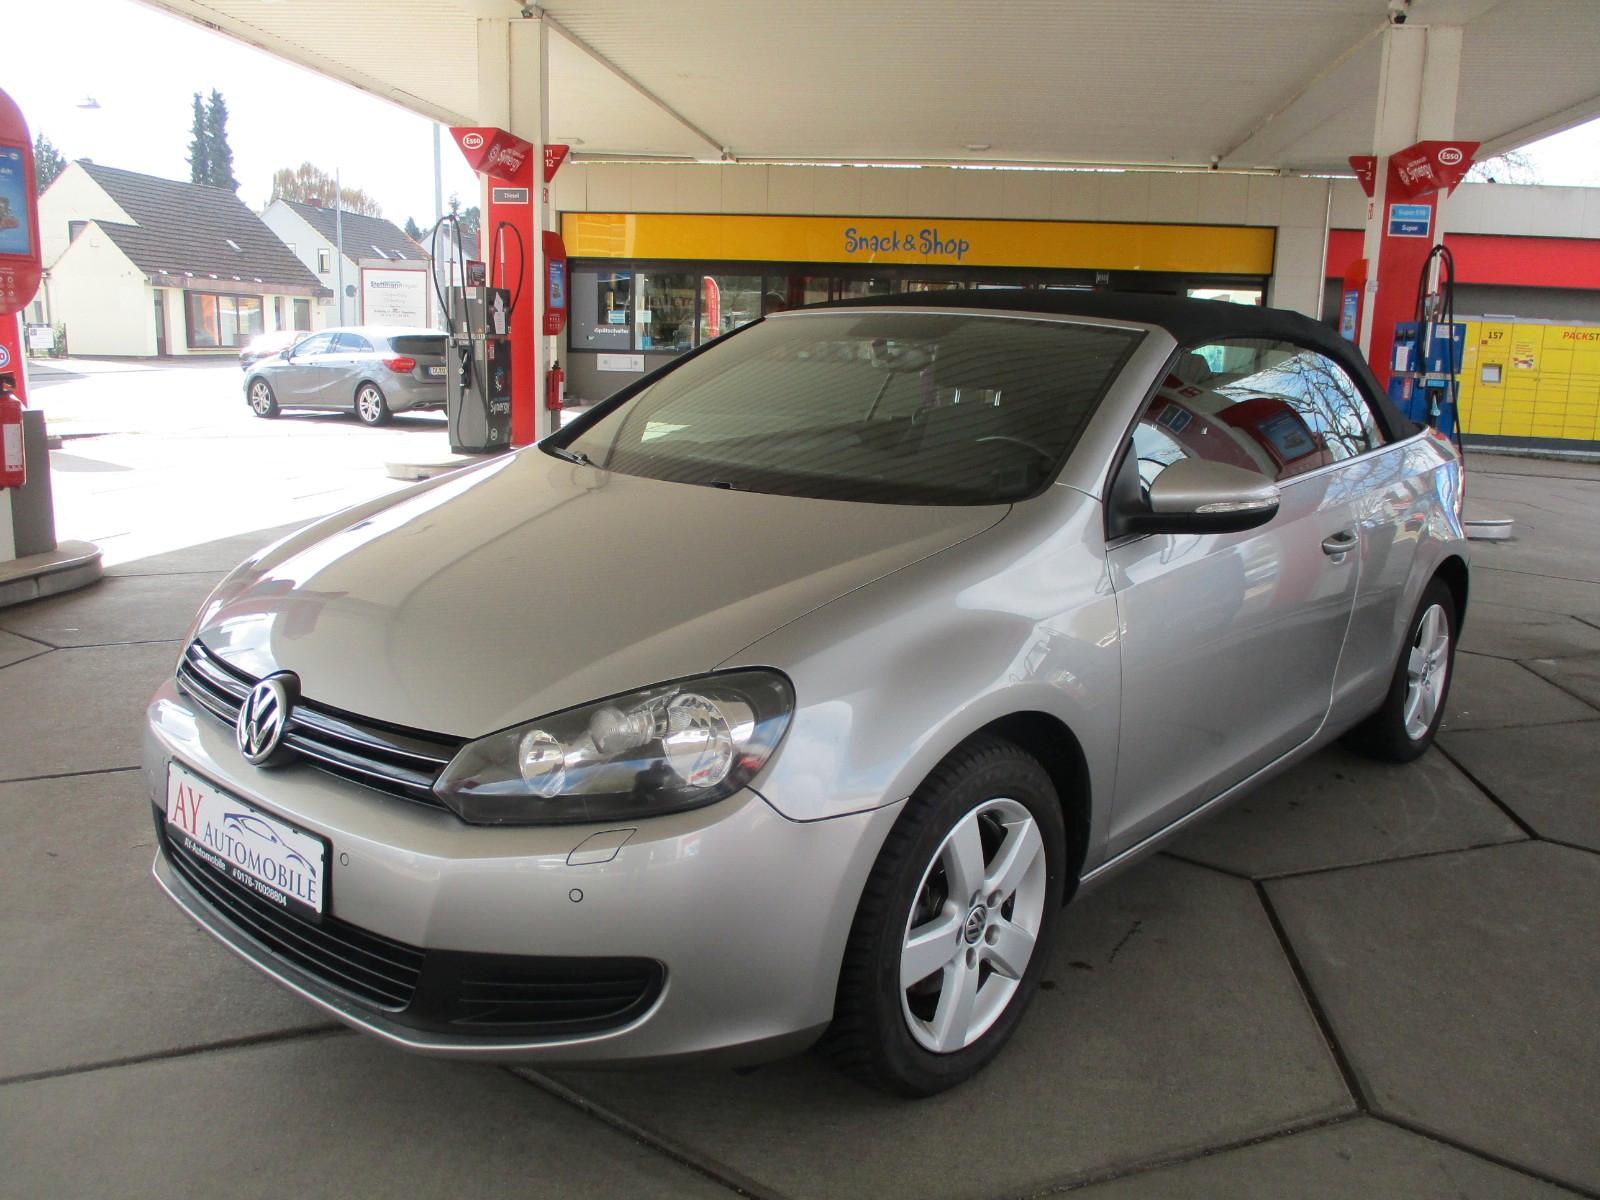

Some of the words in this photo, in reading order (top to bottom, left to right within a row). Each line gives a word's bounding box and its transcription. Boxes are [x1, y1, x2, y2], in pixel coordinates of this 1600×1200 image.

[466, 137, 481, 145] Esso
[545, 149, 553, 158] 11
[1441, 151, 1459, 160] Esso
[545, 159, 554, 167] 12
[1365, 171, 1372, 180] 2
[1401, 224, 1419, 232] Super
[845, 227, 900, 253] Snack
[903, 234, 916, 251] &
[919, 228, 969, 260] Shop
[1488, 331, 1504, 340] 157
[1562, 331, 1600, 342] PACKST
[490, 400, 510, 415] Synergy
[172, 781, 203, 836] AY
[203, 822, 317, 904] AUTOMOBILE
